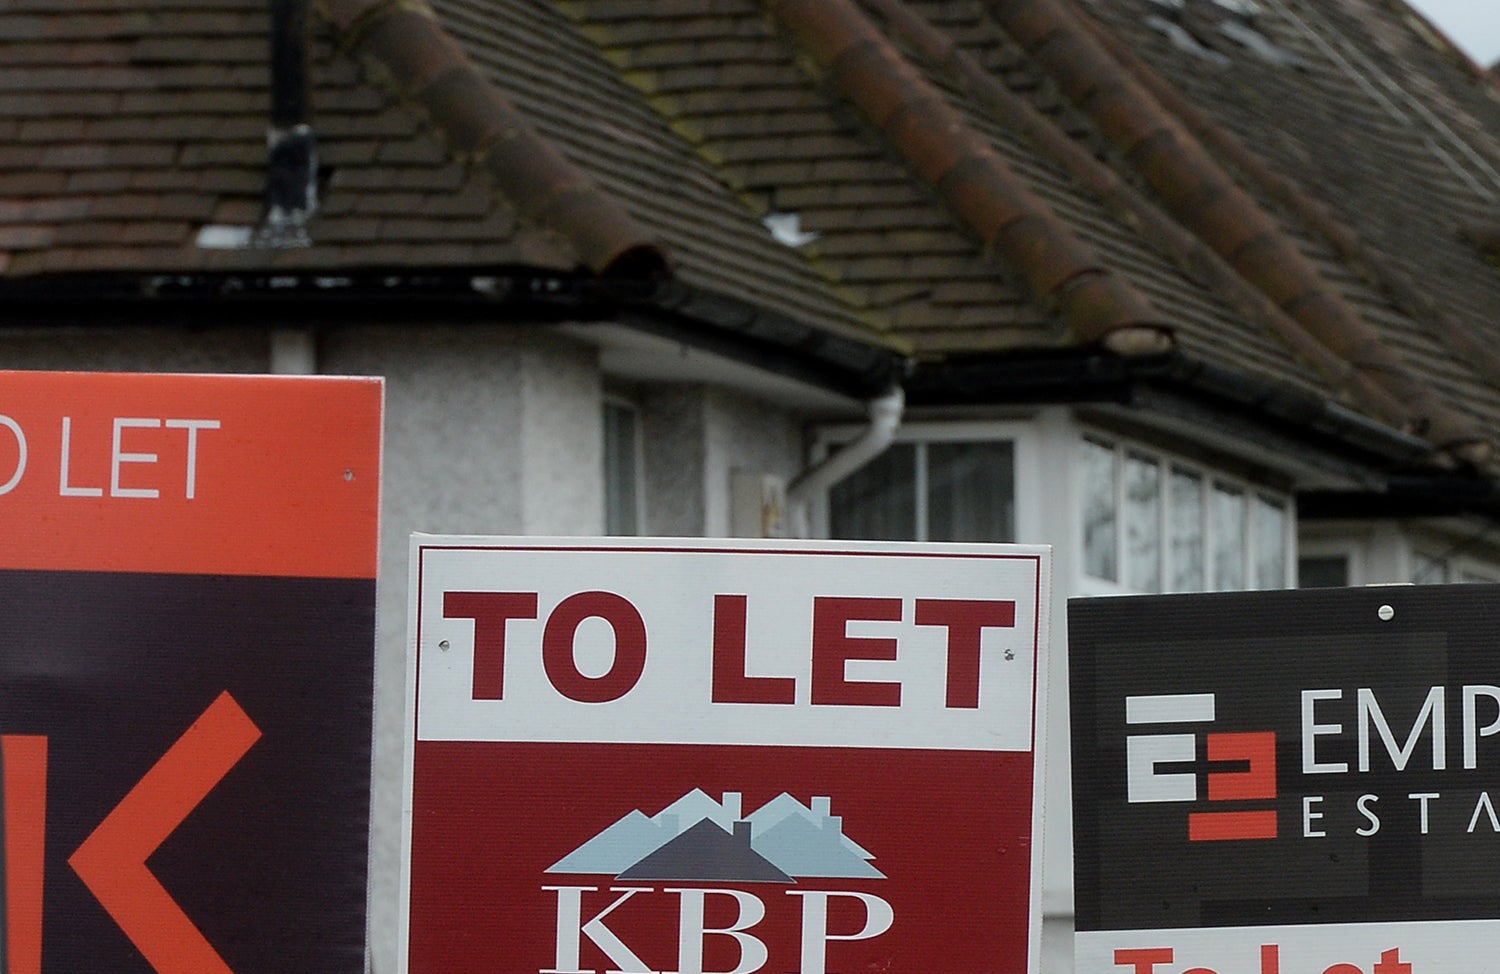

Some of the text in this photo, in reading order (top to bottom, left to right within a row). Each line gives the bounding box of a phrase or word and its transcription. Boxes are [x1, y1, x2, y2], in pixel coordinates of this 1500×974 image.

[59, 415, 222, 500] LET
[442, 589, 1017, 710] TO LET
